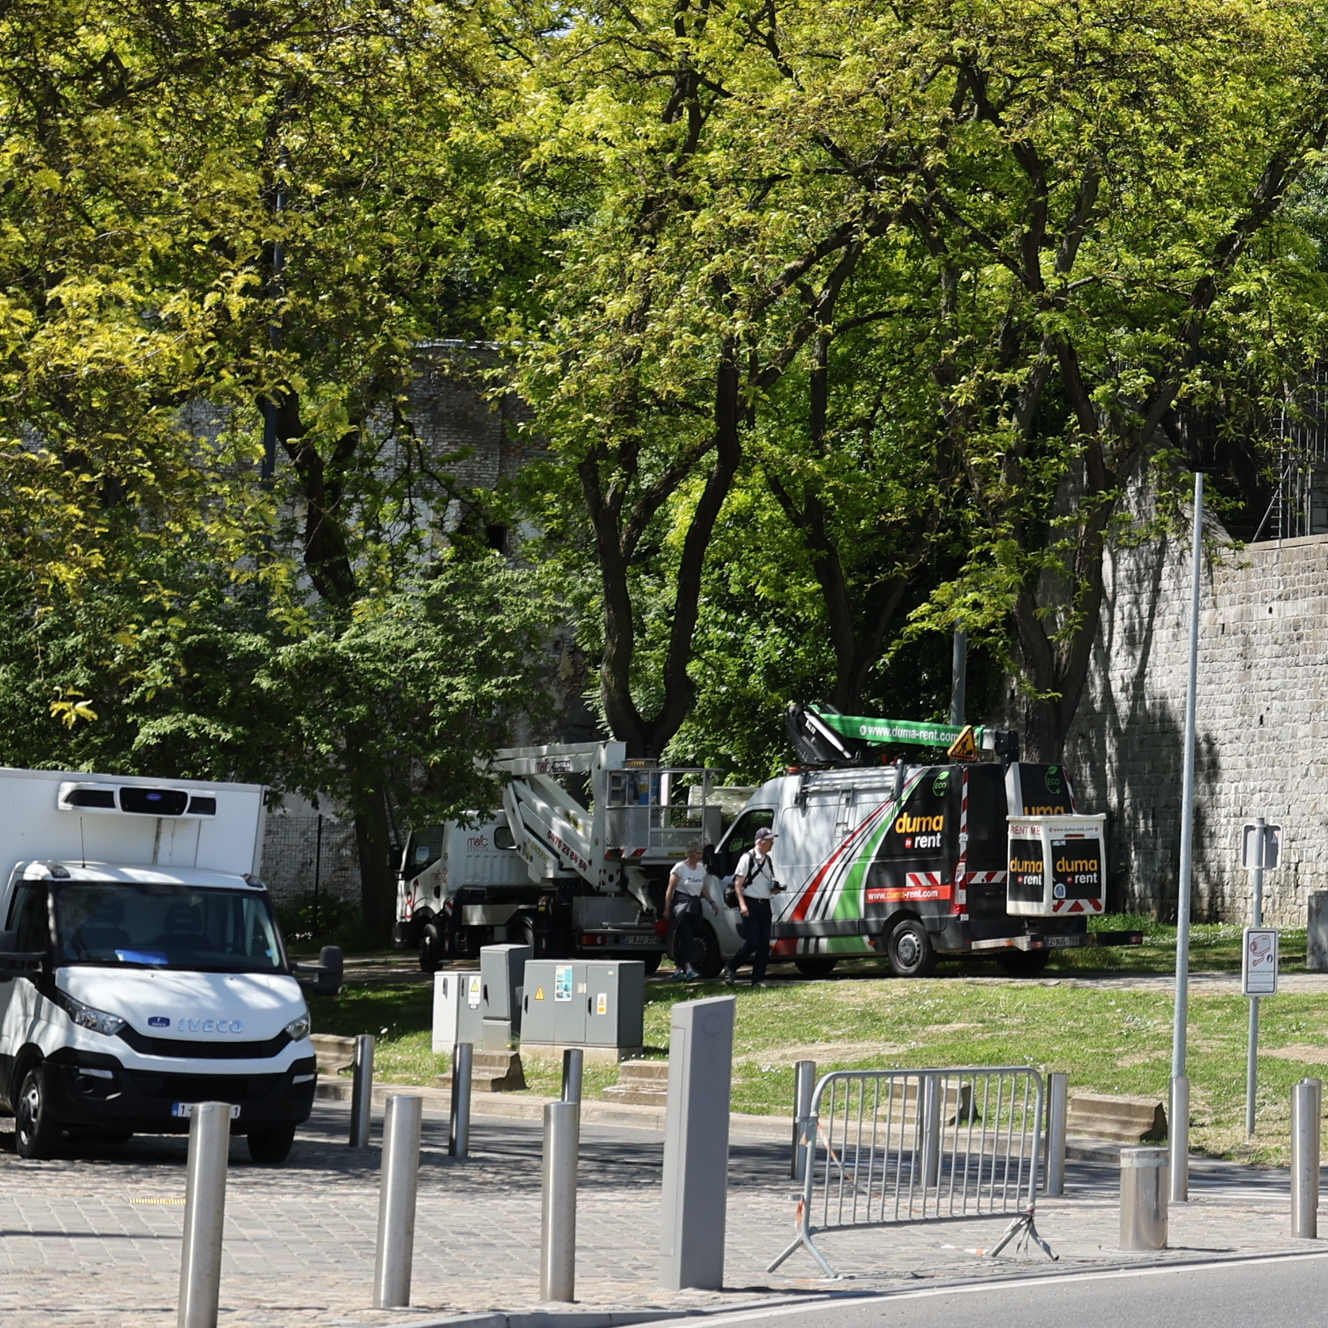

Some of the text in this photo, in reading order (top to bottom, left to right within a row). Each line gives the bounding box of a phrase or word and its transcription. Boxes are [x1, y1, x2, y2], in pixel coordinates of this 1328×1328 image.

[895, 812, 944, 834] duma
[1010, 825, 1028, 835] RENT
[914, 833, 942, 849] rent
[1010, 856, 1044, 873] duma
[1056, 856, 1098, 872] duma
[1023, 874, 1042, 885] rent
[1074, 873, 1098, 884] rent
[176, 1017, 244, 1033] IVECO
